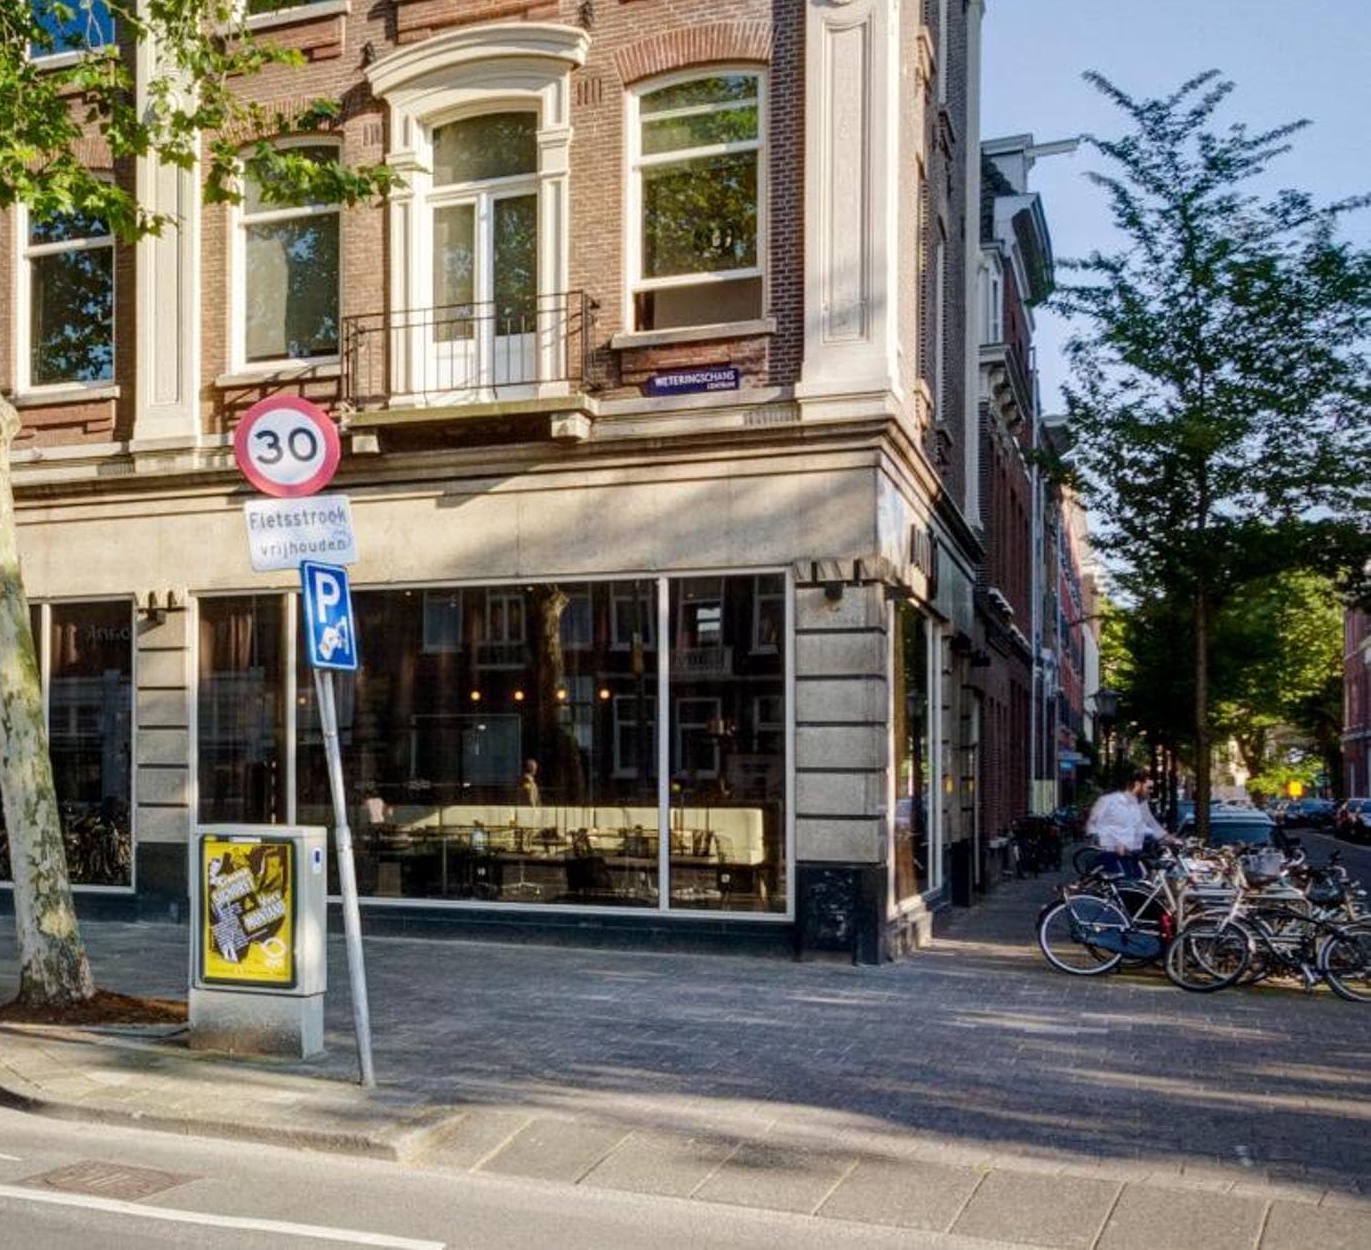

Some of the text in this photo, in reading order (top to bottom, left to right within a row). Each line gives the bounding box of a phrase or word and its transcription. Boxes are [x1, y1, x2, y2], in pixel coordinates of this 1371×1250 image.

[655, 370, 735, 387] WETERINGSCHANS
[253, 426, 318, 465] 30
[249, 505, 347, 531] Fietsstrook
[260, 536, 348, 559] vrijhouden
[314, 571, 340, 624] P
